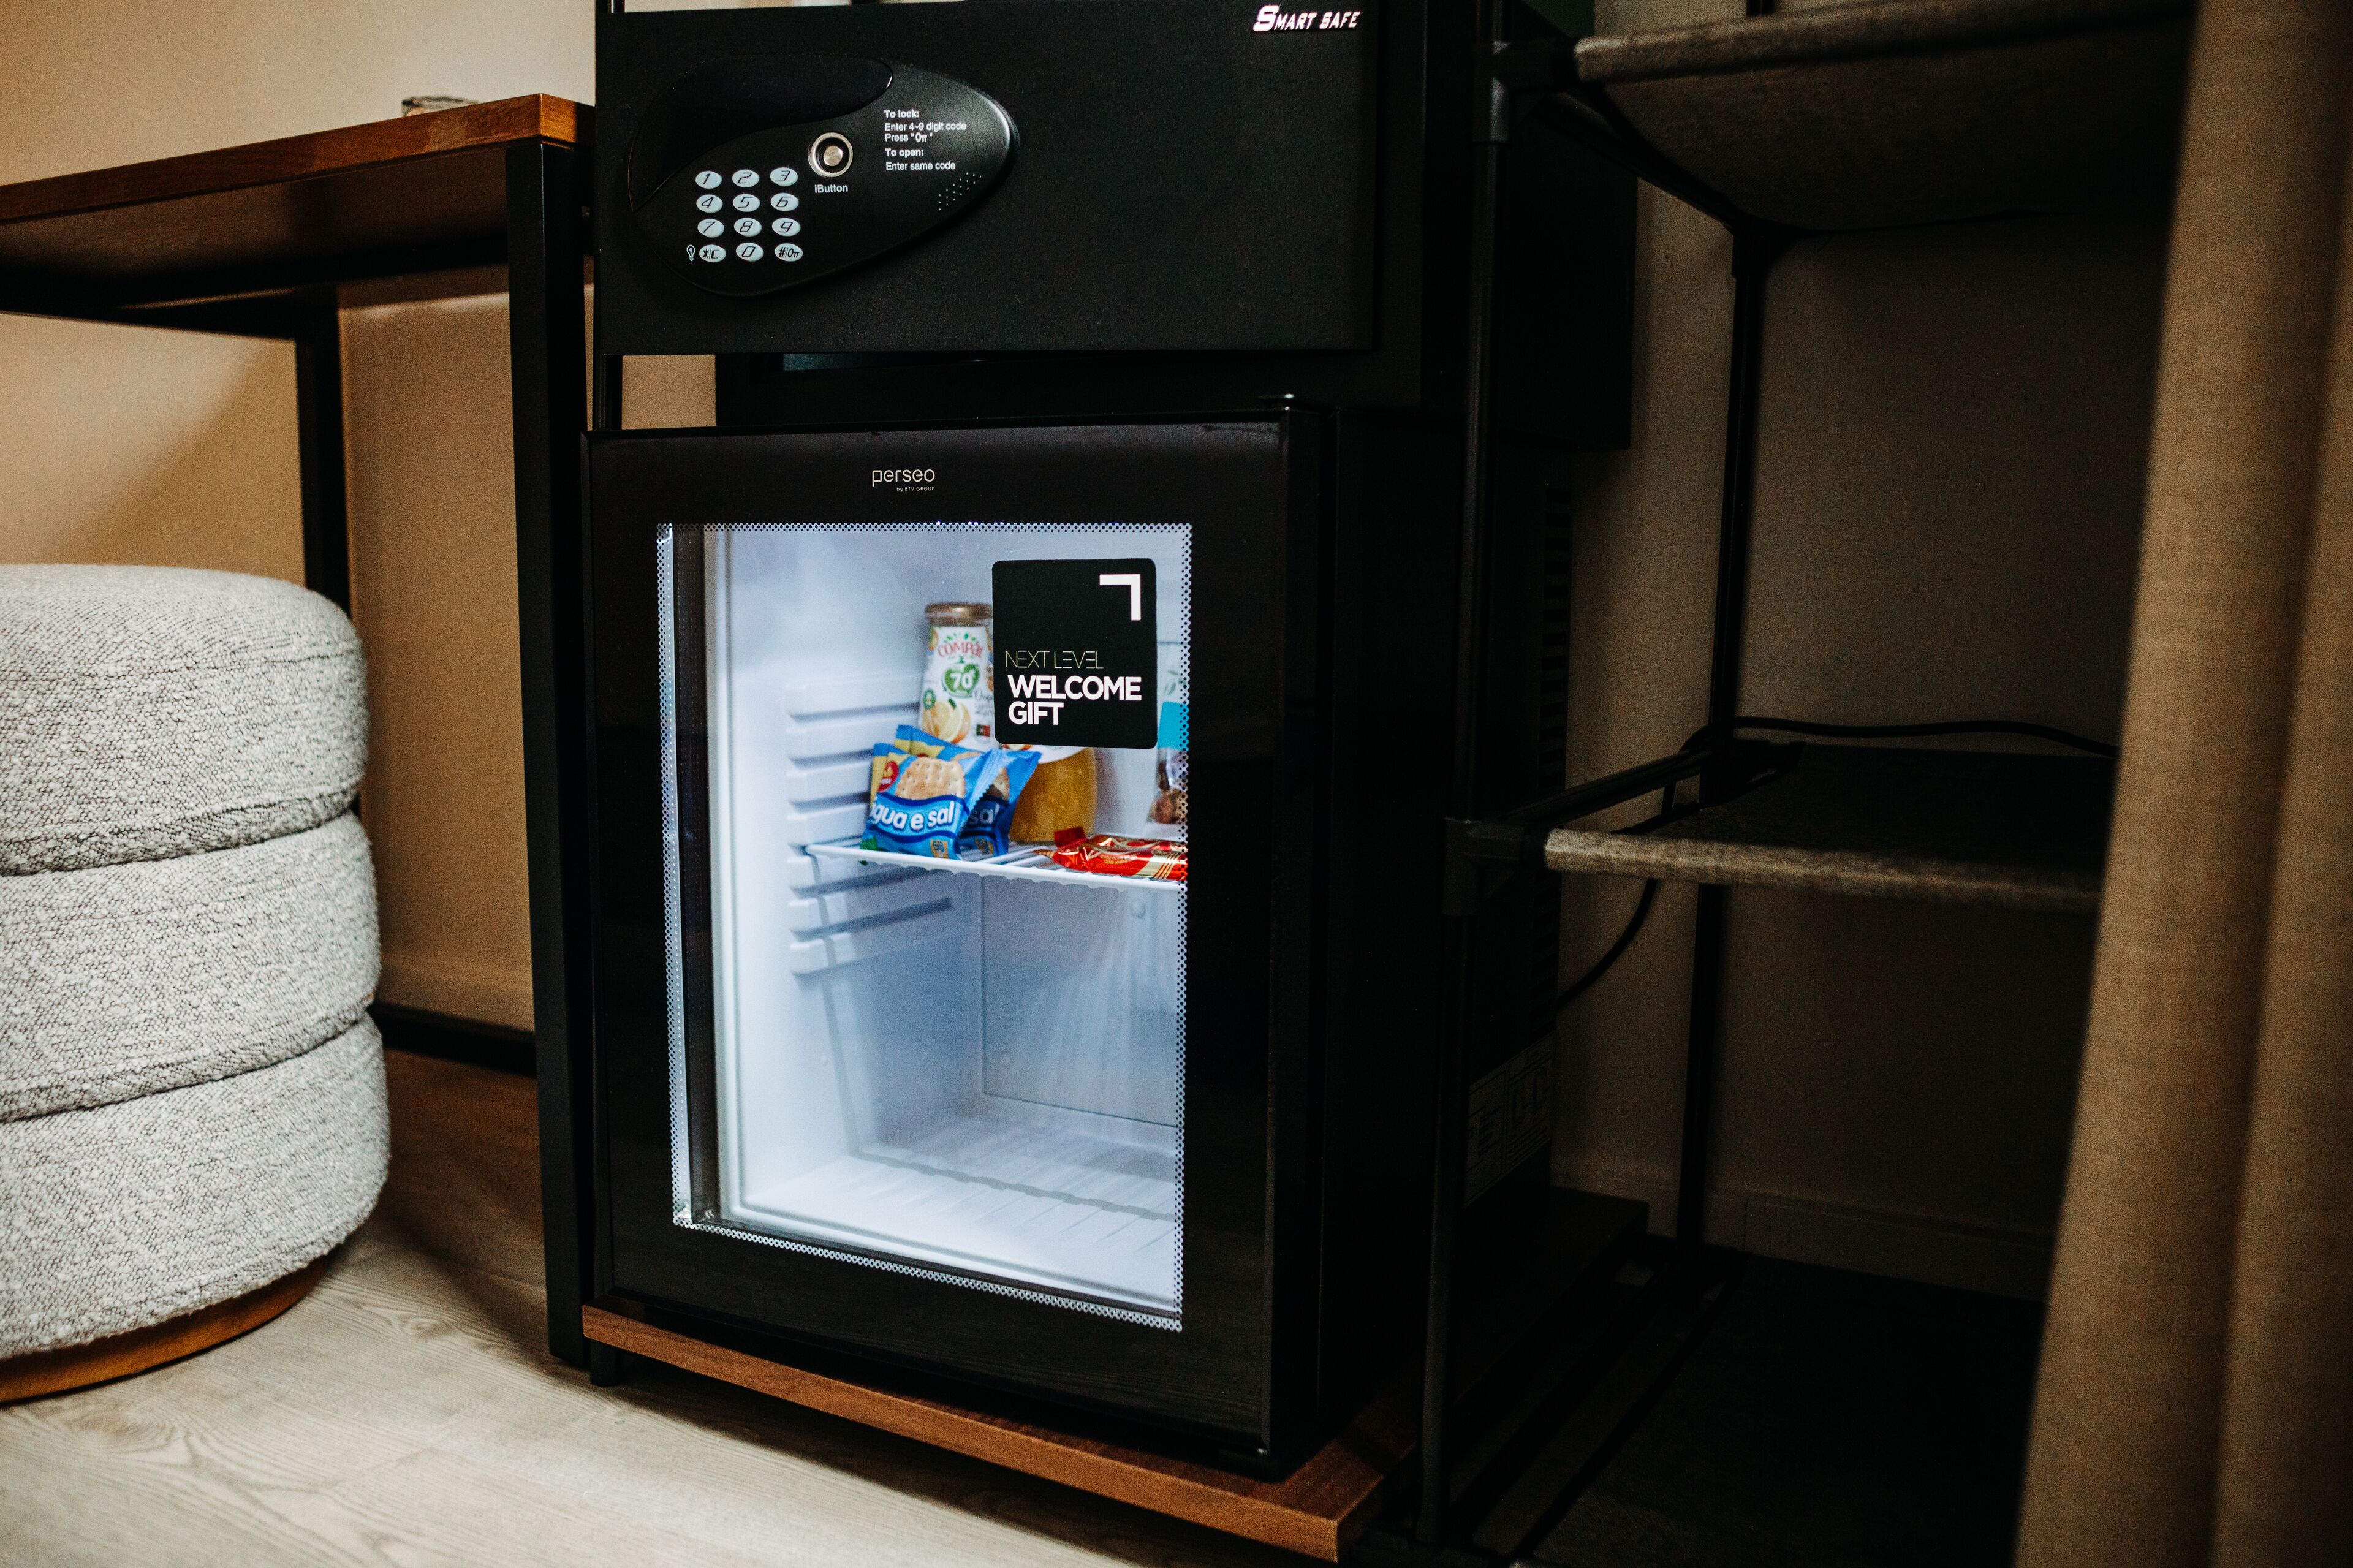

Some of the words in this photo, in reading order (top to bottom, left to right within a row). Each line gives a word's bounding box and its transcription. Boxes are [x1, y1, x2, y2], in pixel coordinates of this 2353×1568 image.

[1253, 5, 1317, 31] SMART
[1319, 11, 1361, 29] SAFE
[884, 110, 896, 118] To
[898, 109, 920, 118] lock:
[885, 123, 907, 131] Enter
[926, 122, 944, 132] digit
[945, 122, 967, 131] code
[885, 133, 909, 142] Press
[885, 148, 896, 156] To
[899, 148, 924, 158] open:
[885, 162, 908, 170] Enter
[910, 162, 933, 170] same
[935, 161, 956, 170] code
[703, 173, 711, 184] 1
[737, 172, 752, 184] 2
[775, 170, 790, 181] 3
[814, 184, 849, 194] iButton
[701, 197, 714, 208] 4
[738, 196, 753, 208] 5
[776, 196, 792, 208] 6
[703, 221, 715, 233] 7
[739, 221, 753, 232] 8
[778, 221, 793, 233] 9
[741, 246, 756, 257] 0
[872, 469, 935, 487] perseo
[1006, 650, 1050, 668] NEXT
[1053, 651, 1104, 669] LEVEL
[1007, 675, 1142, 700] WELCOME
[1008, 700, 1064, 725] GIFT
[910, 813, 924, 830] e
[927, 801, 955, 827] sal
